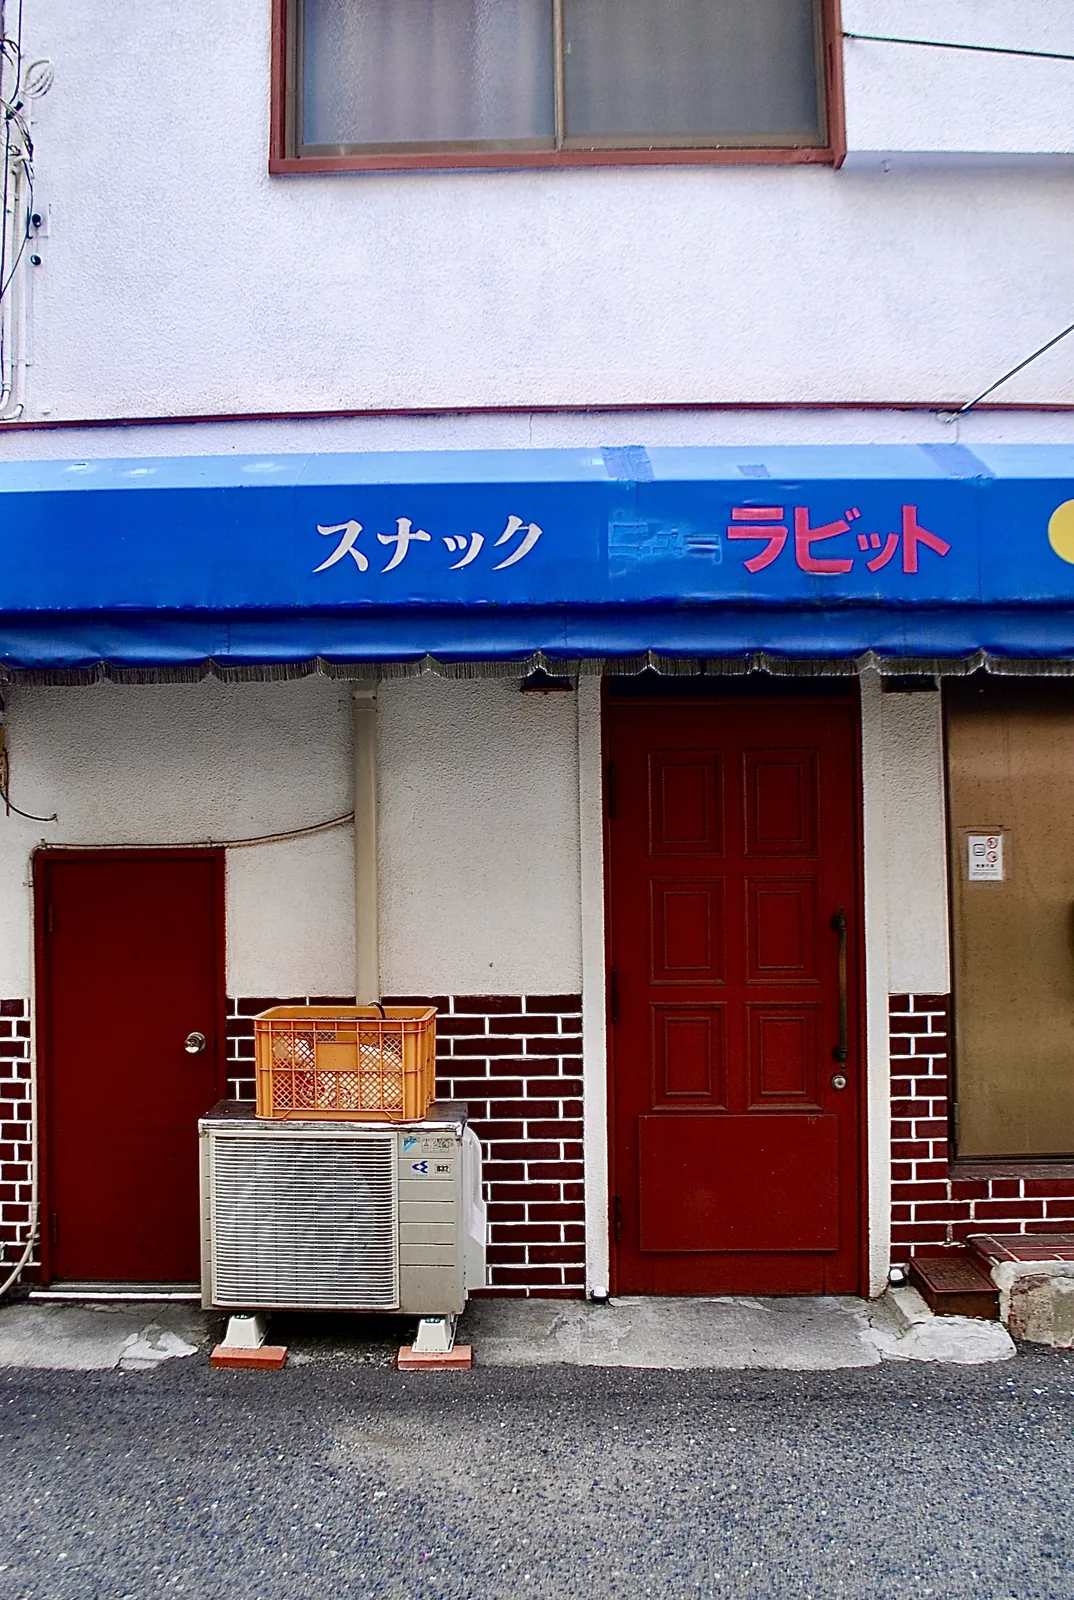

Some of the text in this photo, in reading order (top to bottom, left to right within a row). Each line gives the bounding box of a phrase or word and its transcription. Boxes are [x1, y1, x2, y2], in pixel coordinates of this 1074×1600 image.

[312, 514, 543, 573] スナック
[727, 504, 952, 574] ラビット
